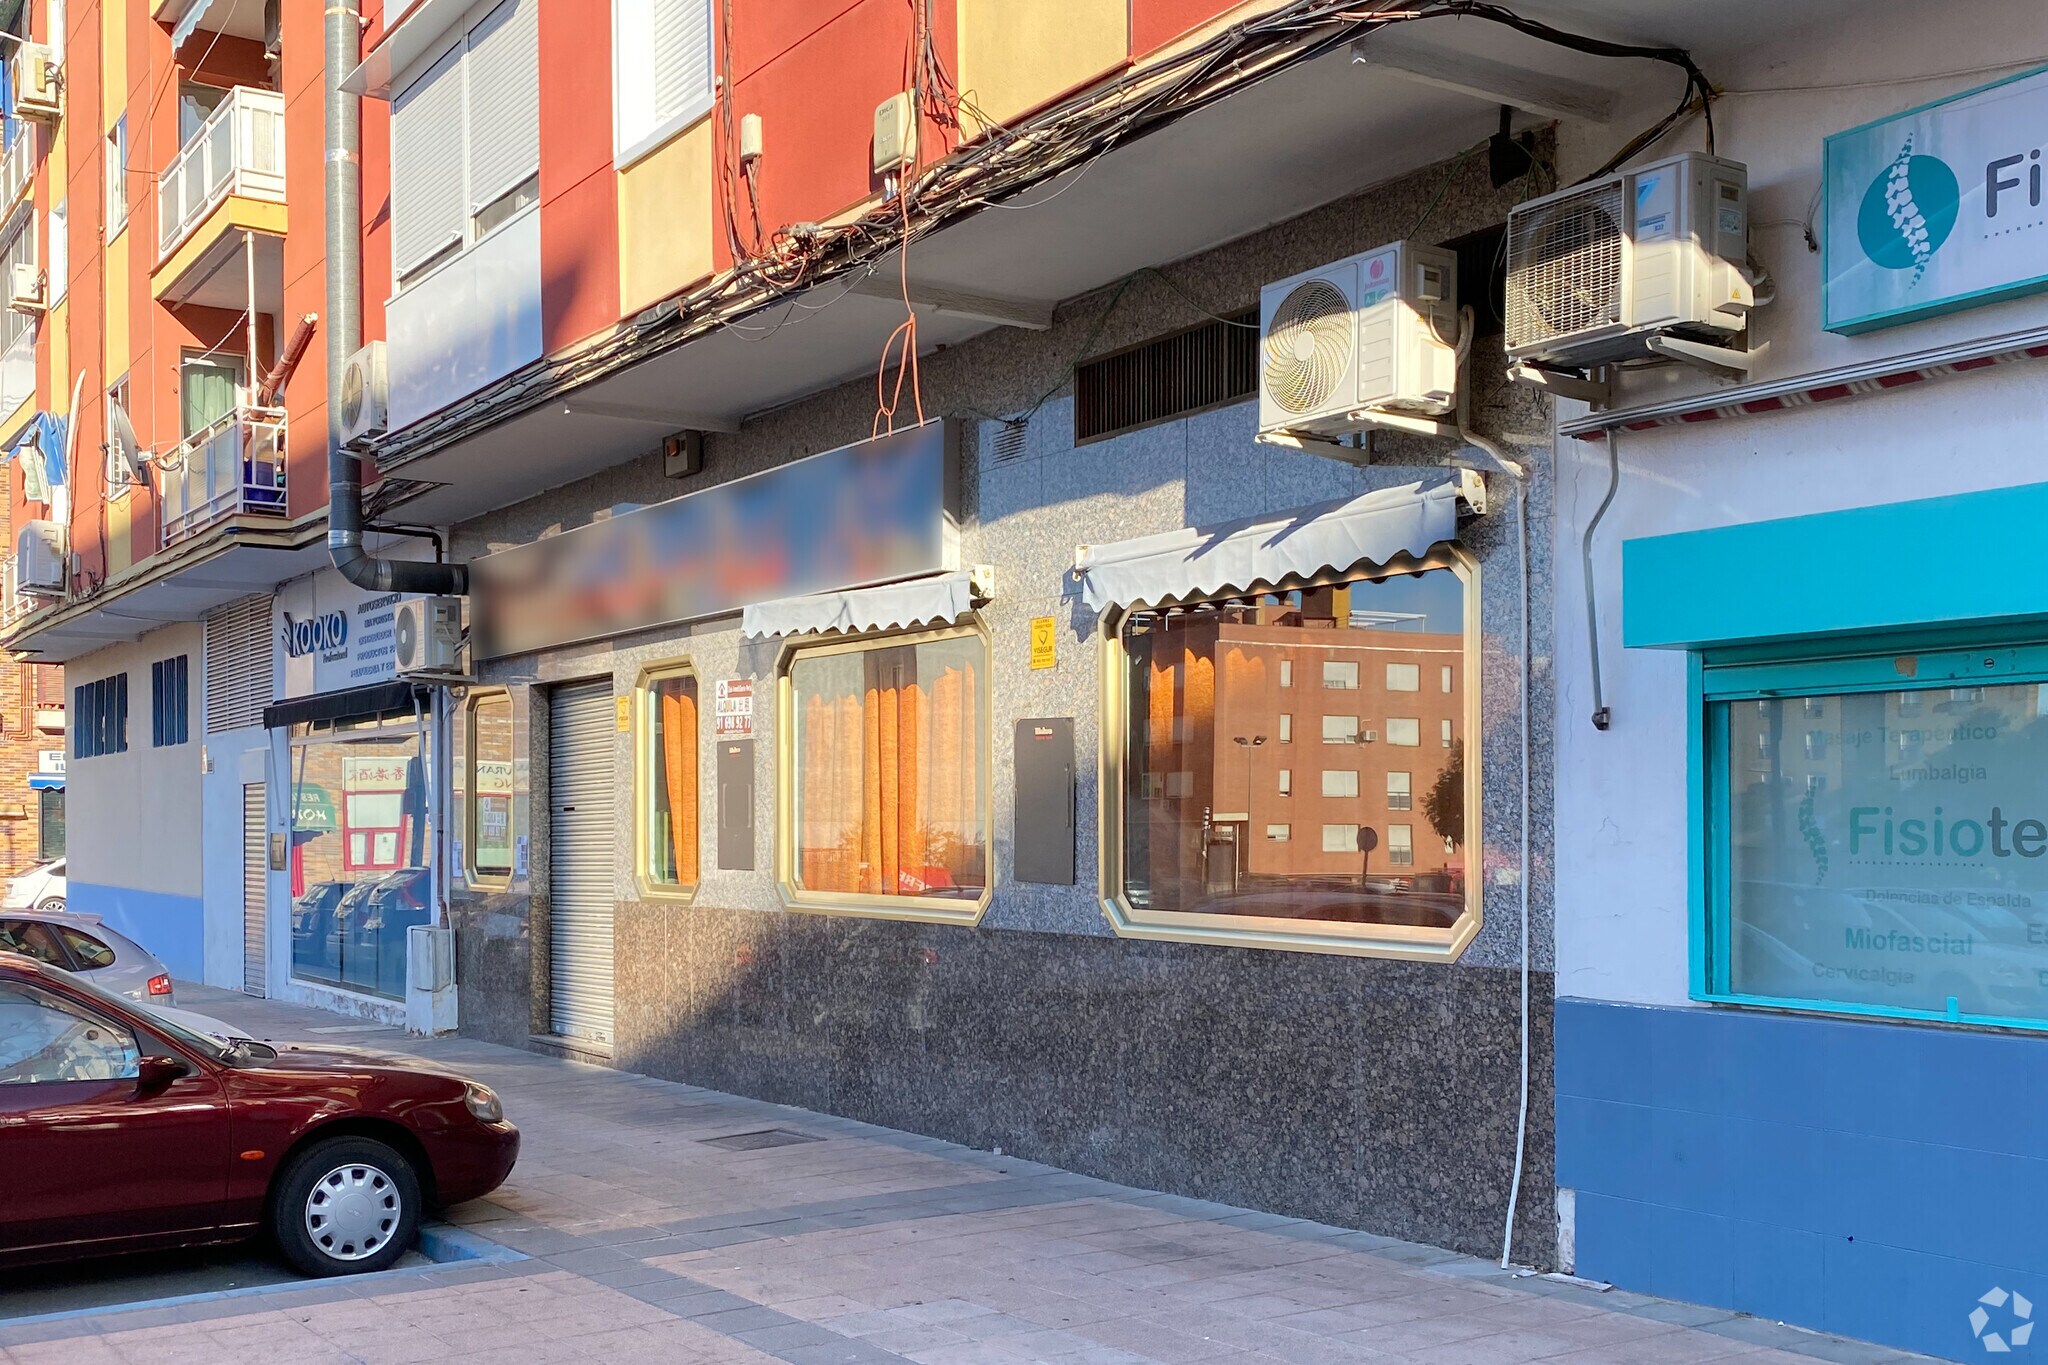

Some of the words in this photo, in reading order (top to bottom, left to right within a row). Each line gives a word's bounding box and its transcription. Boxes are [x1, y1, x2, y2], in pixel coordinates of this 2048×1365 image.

[1986, 149, 2041, 218] Fi
[1849, 806, 2048, 858] Fisiote
[1943, 892, 1962, 906] de
[1845, 926, 1973, 955] Miofascial
[1812, 962, 1917, 987] Cervicalgia
